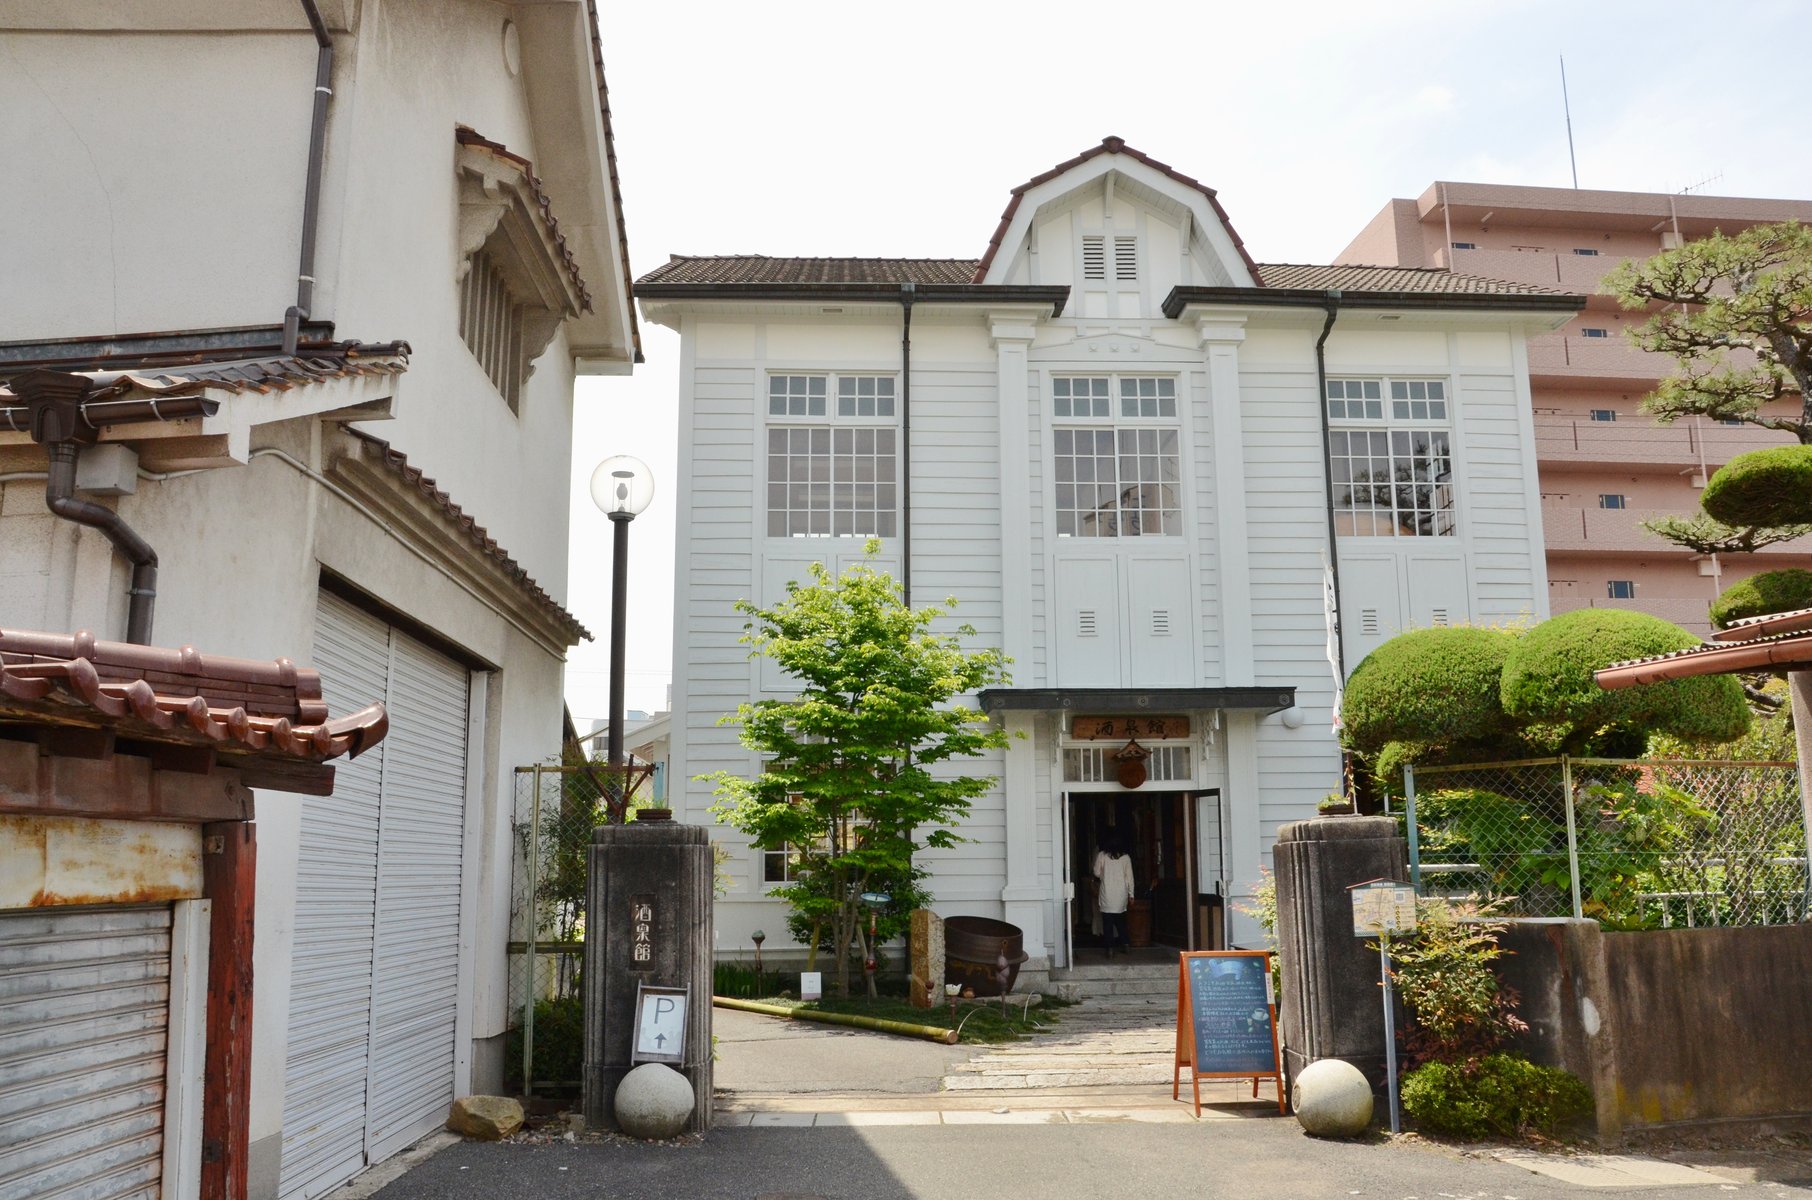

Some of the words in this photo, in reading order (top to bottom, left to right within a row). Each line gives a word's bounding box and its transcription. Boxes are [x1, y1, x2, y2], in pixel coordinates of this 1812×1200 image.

[634, 904, 652, 961] 酒泉館
[654, 997, 675, 1024] P
